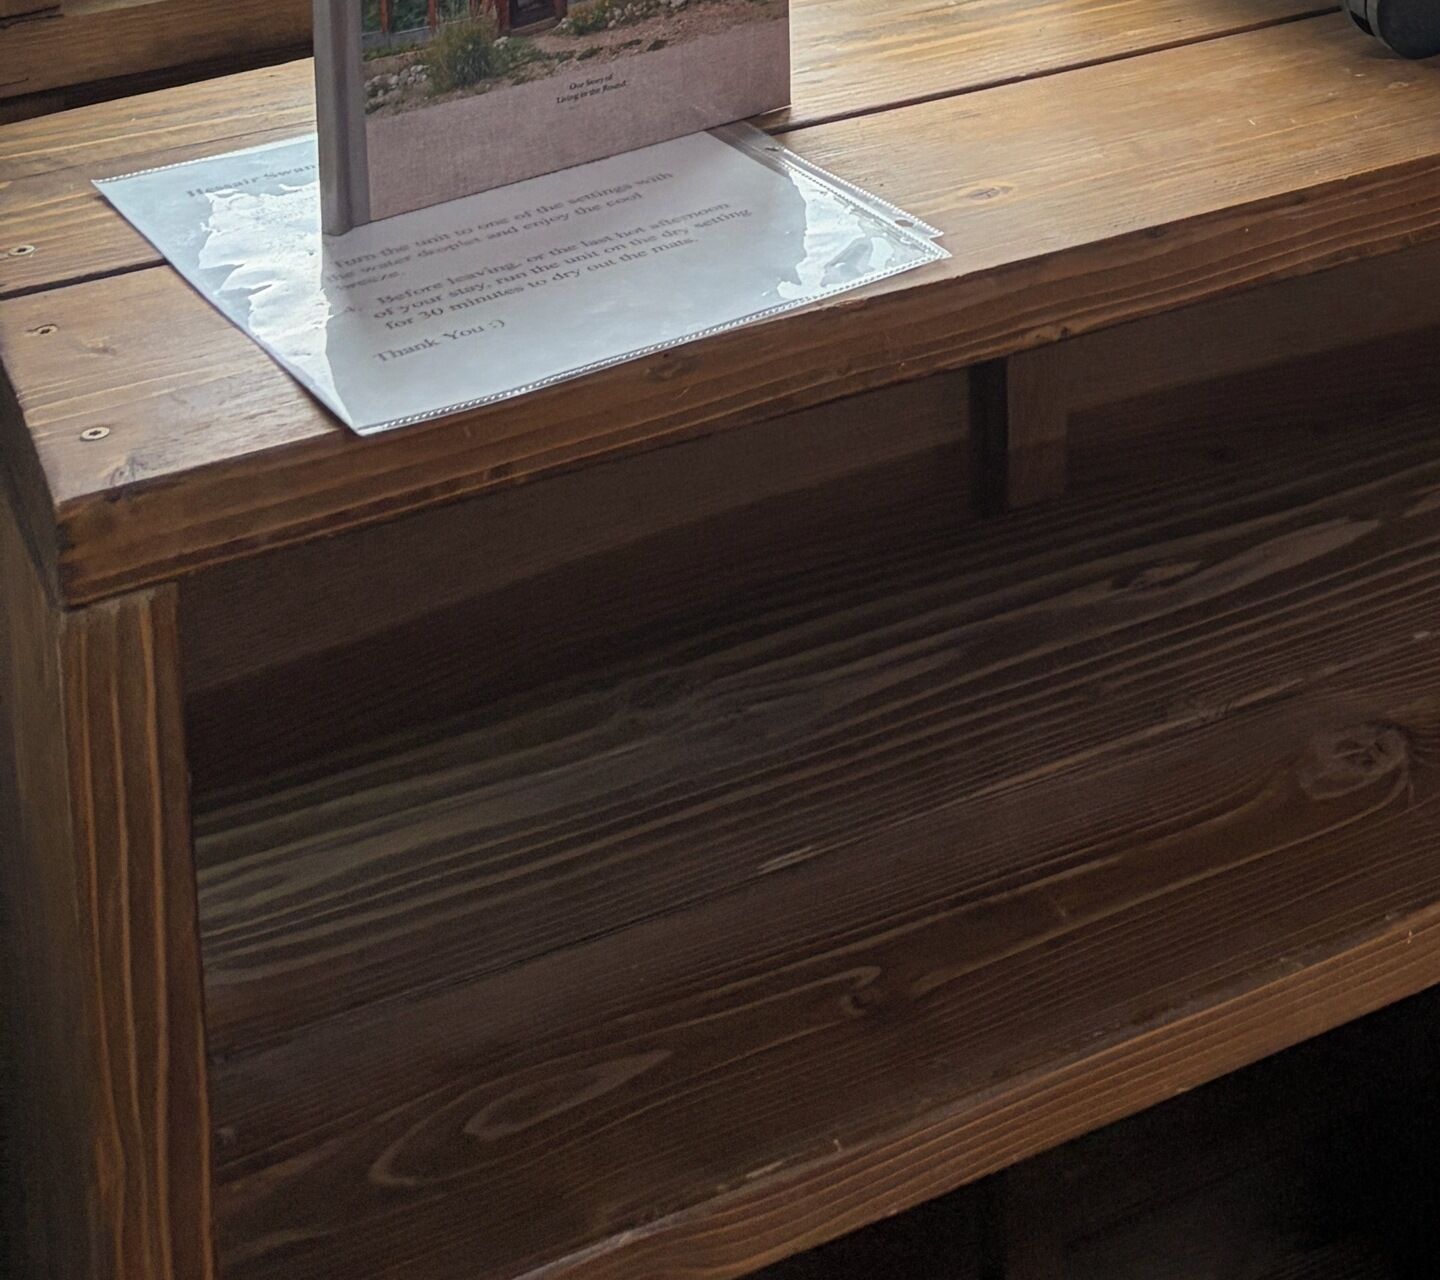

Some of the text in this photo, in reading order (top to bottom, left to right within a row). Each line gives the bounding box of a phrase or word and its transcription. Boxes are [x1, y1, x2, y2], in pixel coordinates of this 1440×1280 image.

[331, 171, 674, 269] Turn the unit to one of the settings with
[361, 255, 412, 273] water
[418, 236, 481, 259] droplet
[488, 226, 519, 241] and
[523, 211, 570, 230] enjoy
[574, 202, 601, 216] the
[606, 191, 643, 207] cool
[373, 307, 396, 320] of
[399, 294, 443, 313] your
[495, 271, 528, 286] run
[530, 260, 560, 274] the
[563, 249, 600, 265] unit
[604, 243, 627, 255] on
[629, 234, 657, 247] the
[661, 225, 689, 239] dry
[693, 207, 752, 229] setting
[377, 280, 443, 305] Before
[526, 253, 545, 264] or
[549, 243, 577, 257] the
[581, 234, 613, 248] last
[615, 226, 645, 240] hot
[649, 201, 731, 230] afternoon
[384, 316, 414, 331] for
[418, 307, 445, 321] 30
[449, 285, 525, 311] minutes
[527, 277, 548, 289] to
[551, 268, 582, 283] dry
[587, 258, 617, 272] out
[619, 248, 649, 262] the
[372, 338, 440, 363] Thank
[443, 324, 485, 341] You
